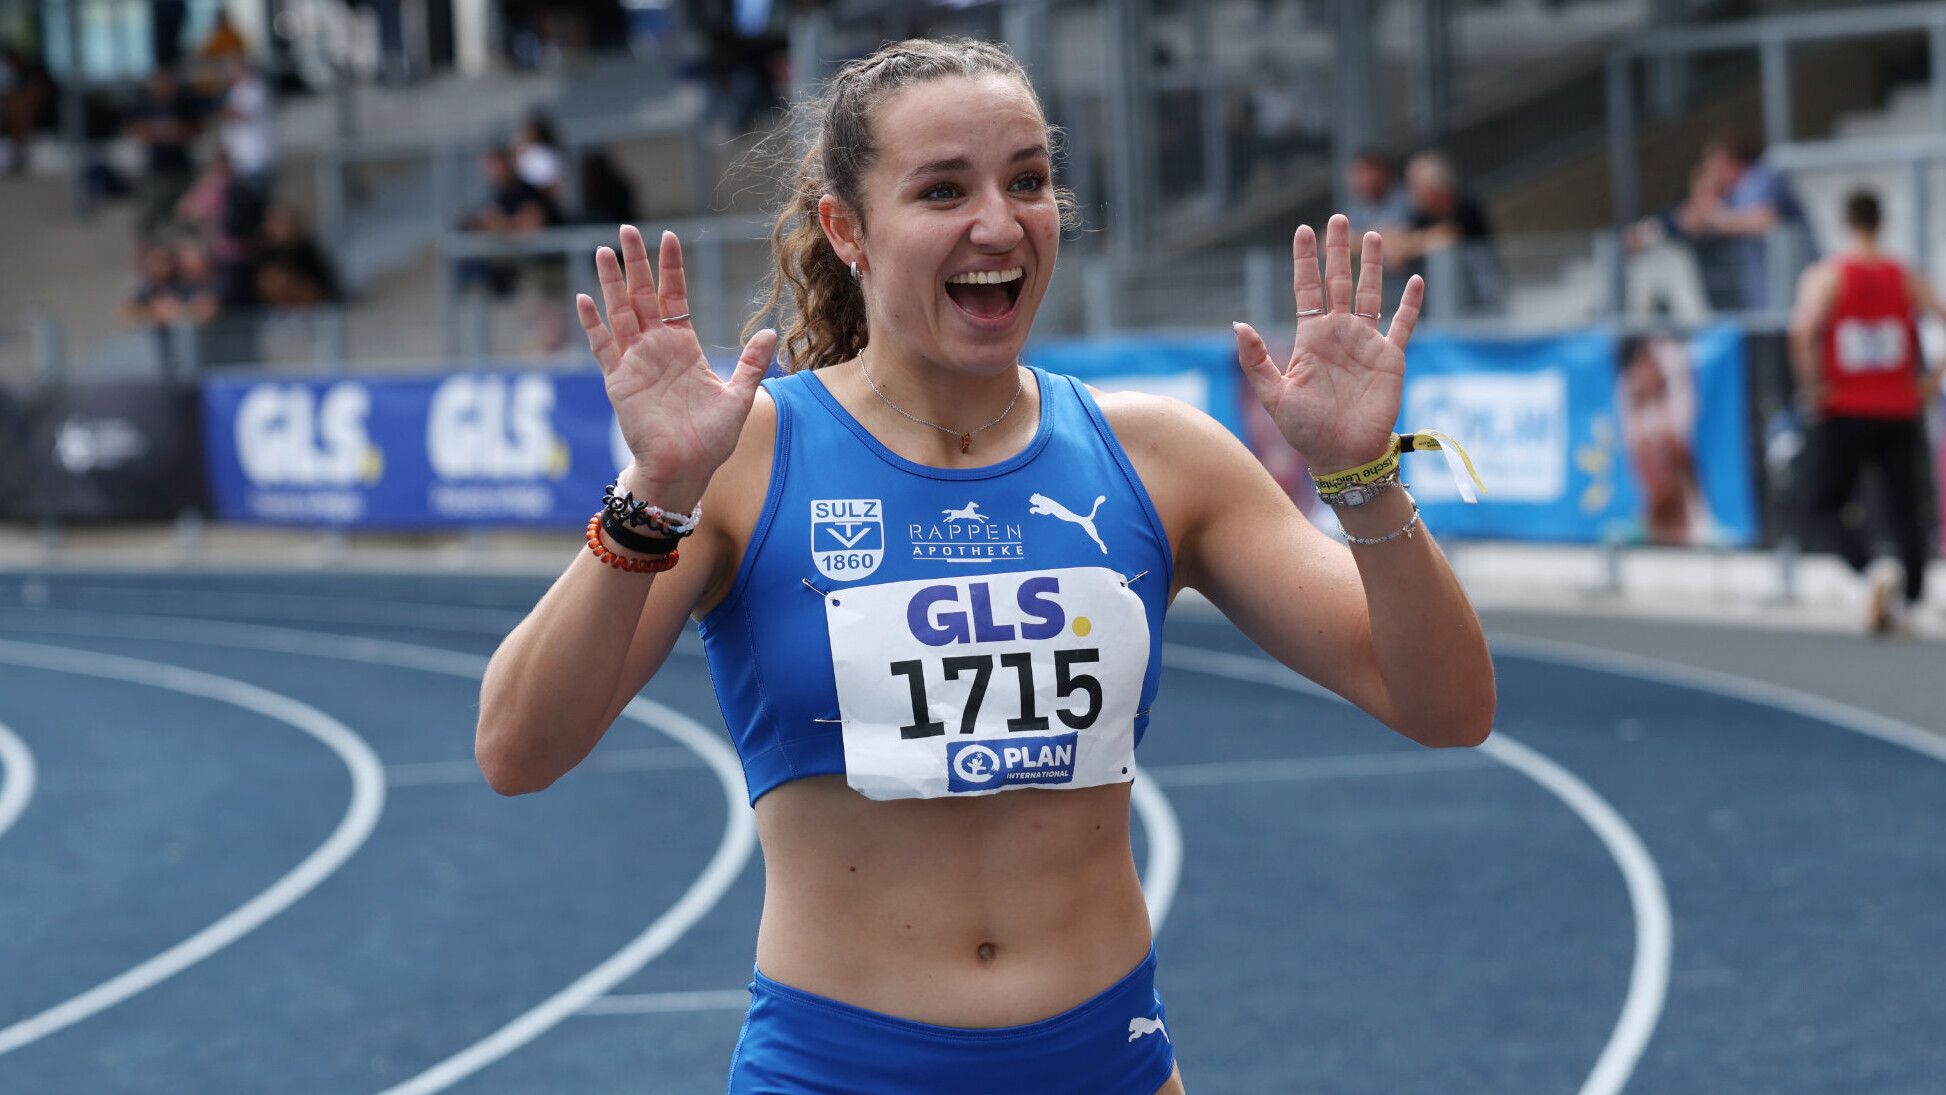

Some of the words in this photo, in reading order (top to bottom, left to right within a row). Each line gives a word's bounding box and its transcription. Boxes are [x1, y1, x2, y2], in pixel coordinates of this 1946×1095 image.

[815, 501, 878, 518] SULZ
[909, 524, 1021, 540] RAPPEN
[912, 545, 1024, 556] APOTHEKE
[822, 553, 873, 571] 1860
[890, 648, 1102, 739] 1715
[1003, 744, 1072, 769] PLAN
[1006, 770, 1069, 780] INTERNATIONAL
